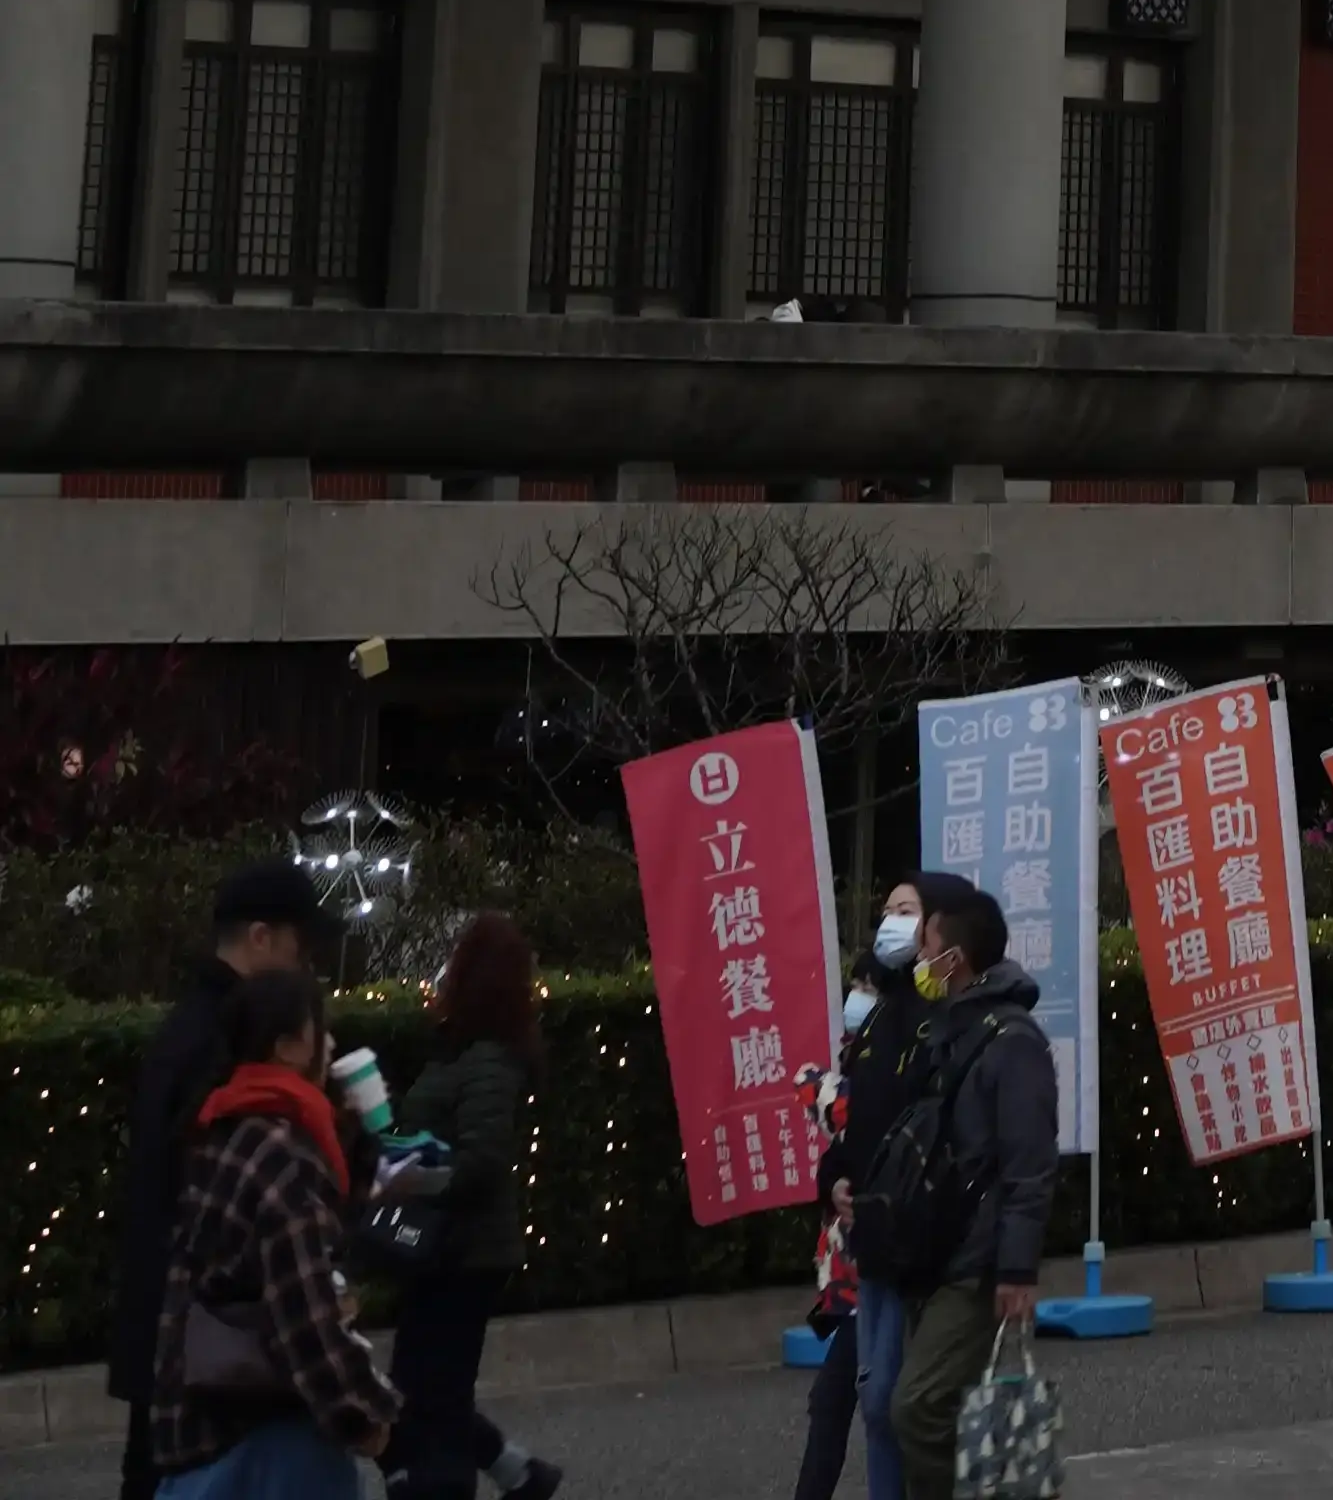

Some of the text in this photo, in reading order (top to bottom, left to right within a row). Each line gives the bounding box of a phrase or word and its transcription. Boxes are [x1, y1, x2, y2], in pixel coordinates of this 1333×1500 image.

[930, 708, 1013, 750] Cafe
[1115, 713, 1204, 761] Cafe
[943, 755, 987, 891] 百匯
[1002, 742, 1052, 971] 自助餐廳
[1135, 759, 1213, 986] 百匯料理
[1203, 742, 1273, 970] 自助餐廳
[699, 819, 786, 1091] 立德餐廳
[1192, 975, 1262, 1007] BUFFET
